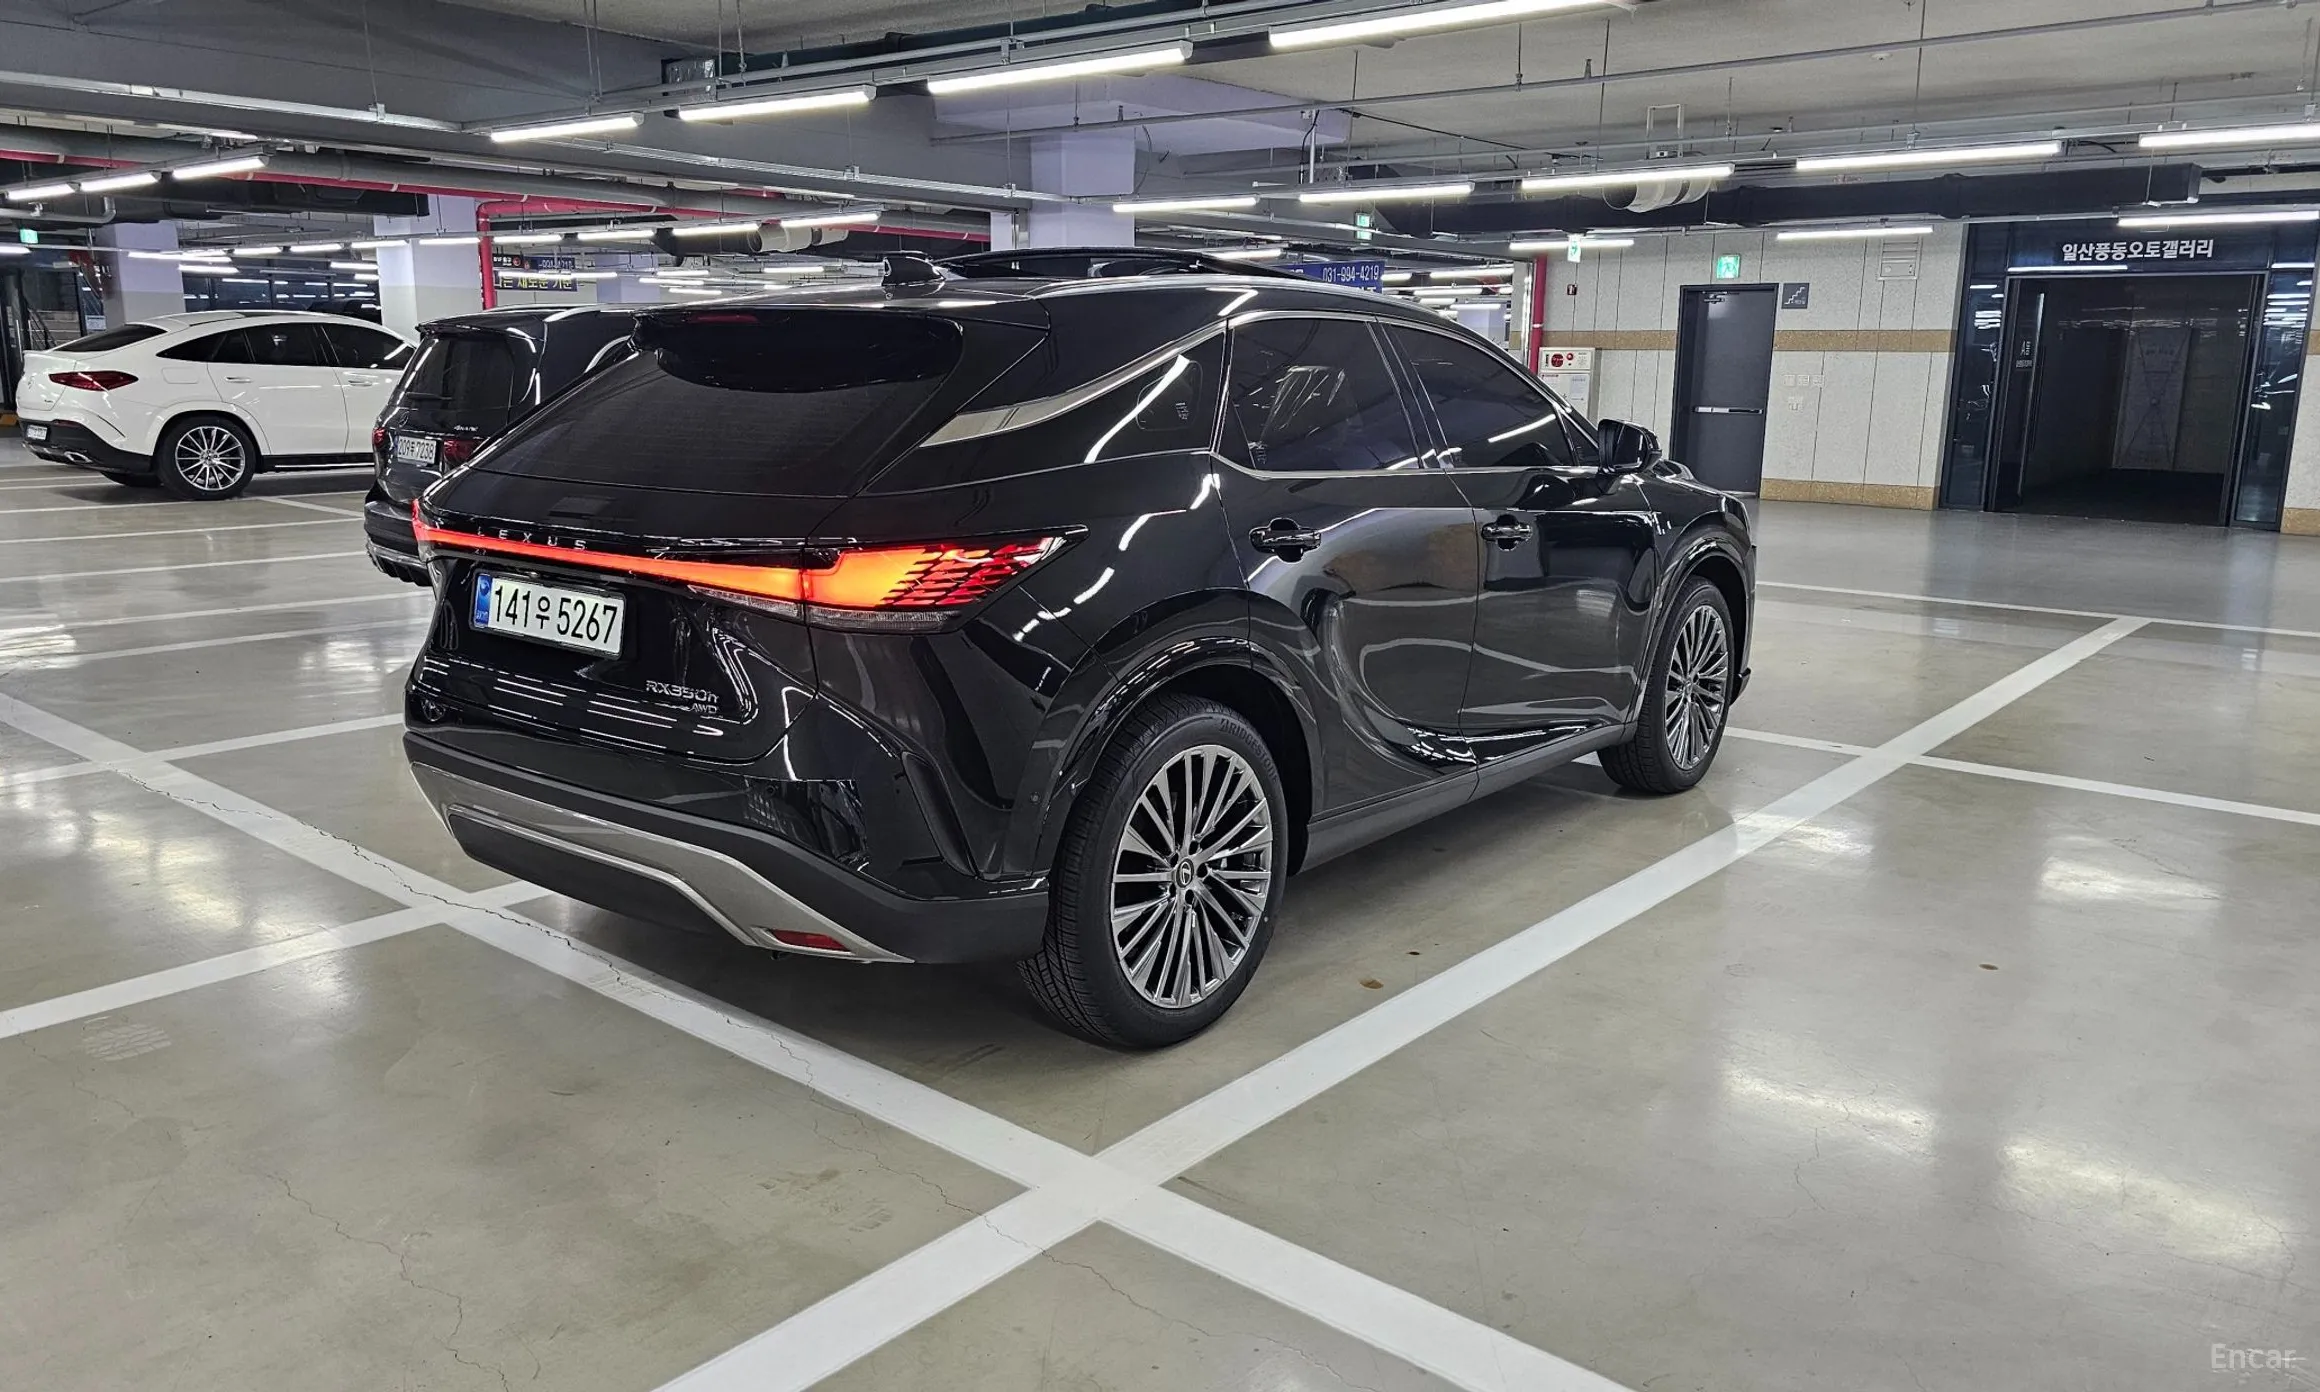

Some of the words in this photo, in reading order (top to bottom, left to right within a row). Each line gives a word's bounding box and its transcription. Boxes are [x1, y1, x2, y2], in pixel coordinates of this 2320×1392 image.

[2062, 239, 2214, 262] 일산풍동오토갤러리
[1322, 264, 1380, 283] 031-994-4219
[477, 526, 587, 551] LEXUS
[646, 680, 719, 703] RX350h
[692, 702, 718, 714] AWD
